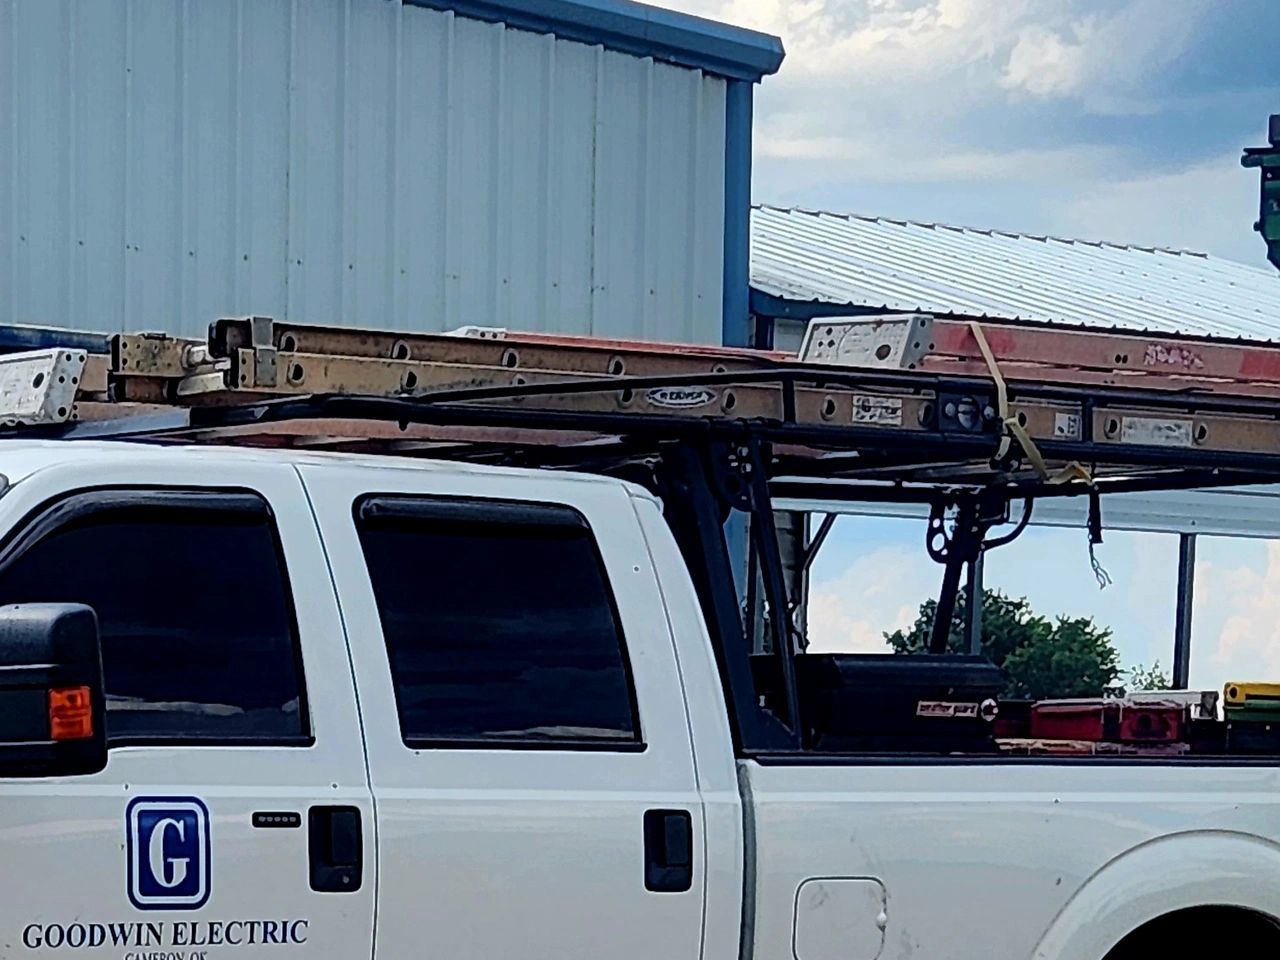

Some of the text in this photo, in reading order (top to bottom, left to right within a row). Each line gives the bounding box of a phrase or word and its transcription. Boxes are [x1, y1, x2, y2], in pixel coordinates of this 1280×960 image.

[149, 817, 191, 888] G
[22, 919, 309, 949] GOODWIN ELECTRIC
